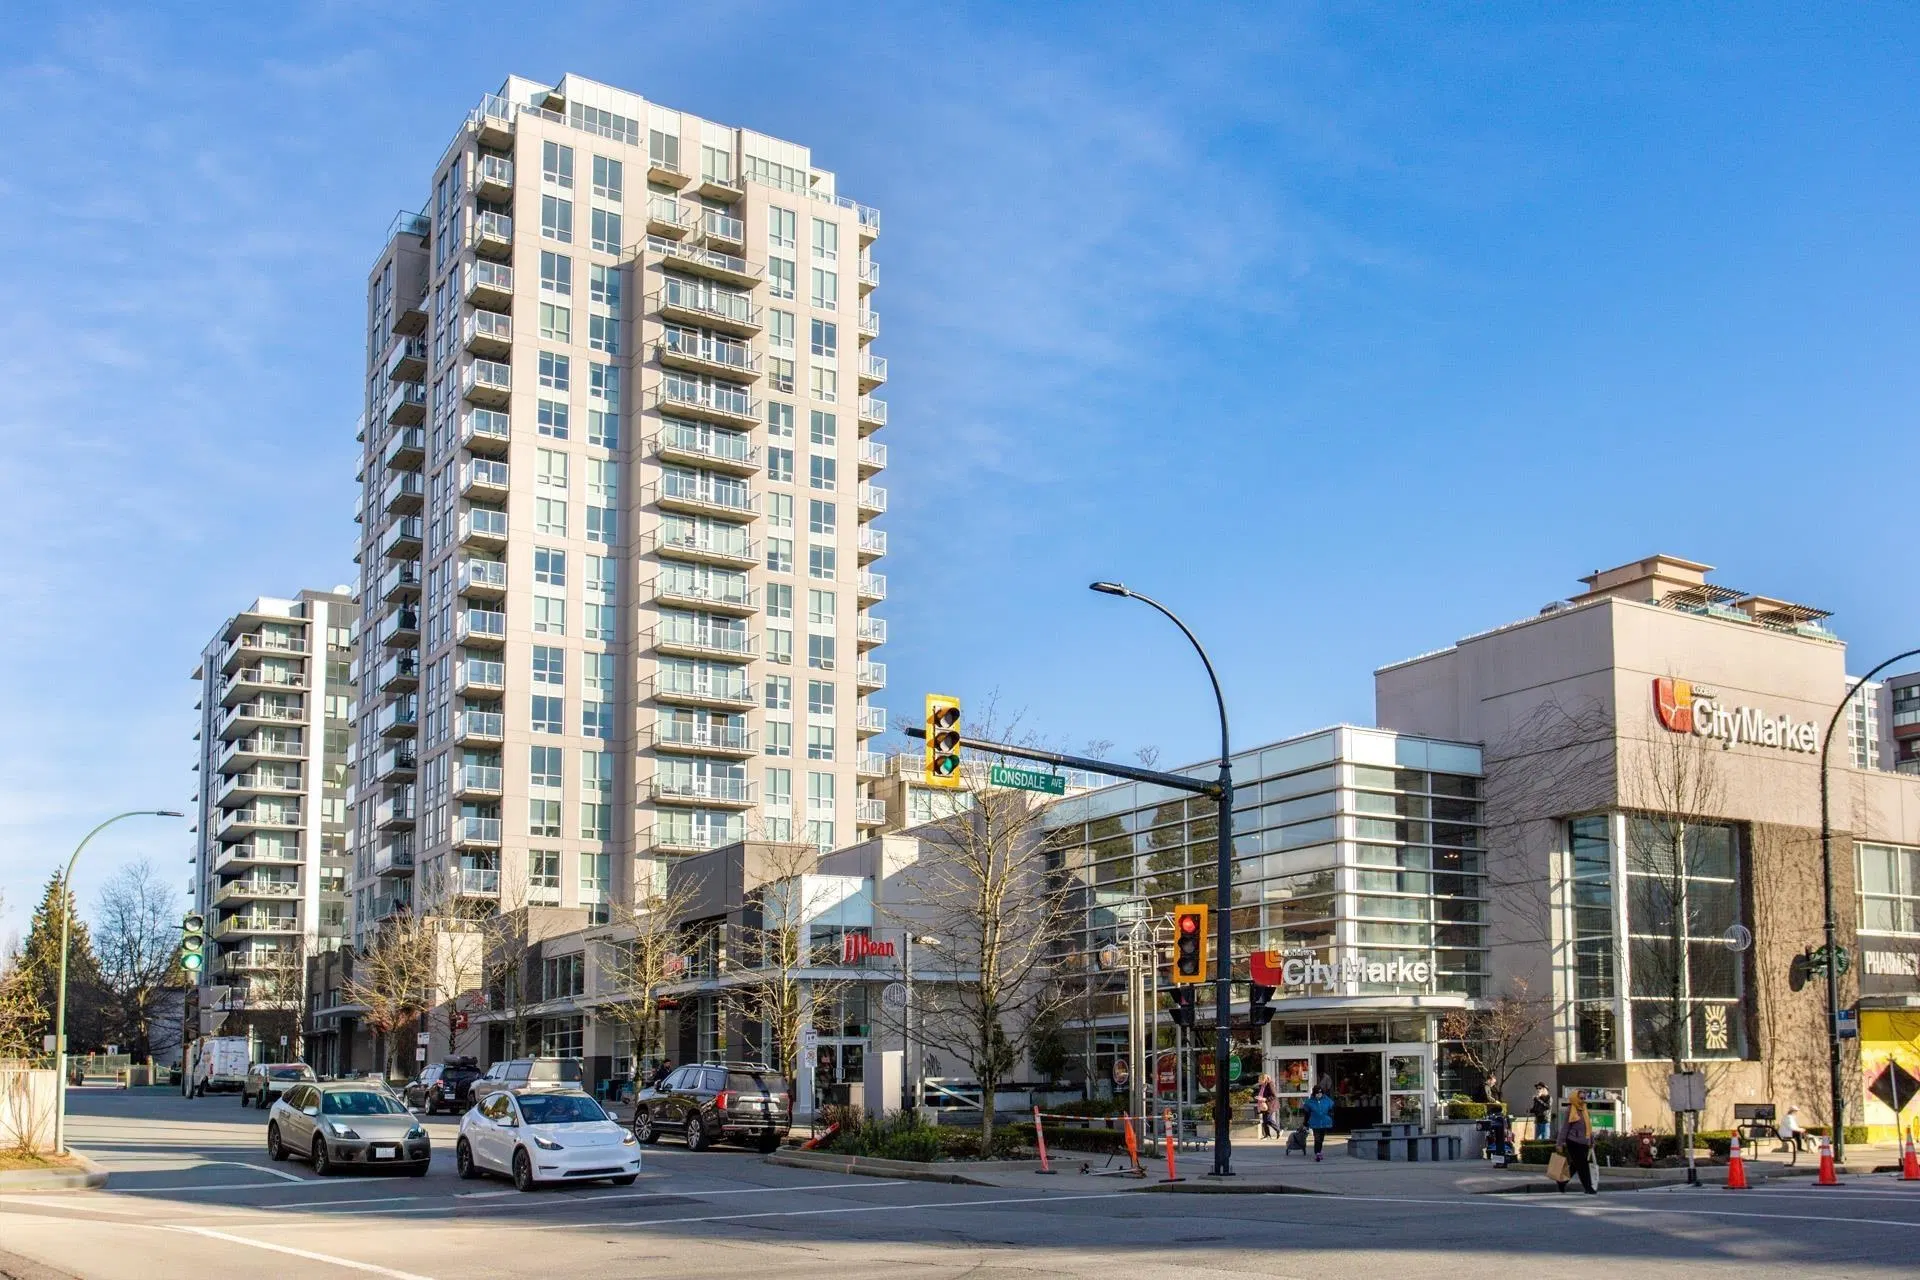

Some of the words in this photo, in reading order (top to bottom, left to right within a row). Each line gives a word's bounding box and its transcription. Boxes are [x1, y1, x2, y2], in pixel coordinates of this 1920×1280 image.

[1692, 698, 1821, 753] CityMarket
[994, 768, 1046, 790] LONSDALE
[1050, 777, 1064, 788] AVE
